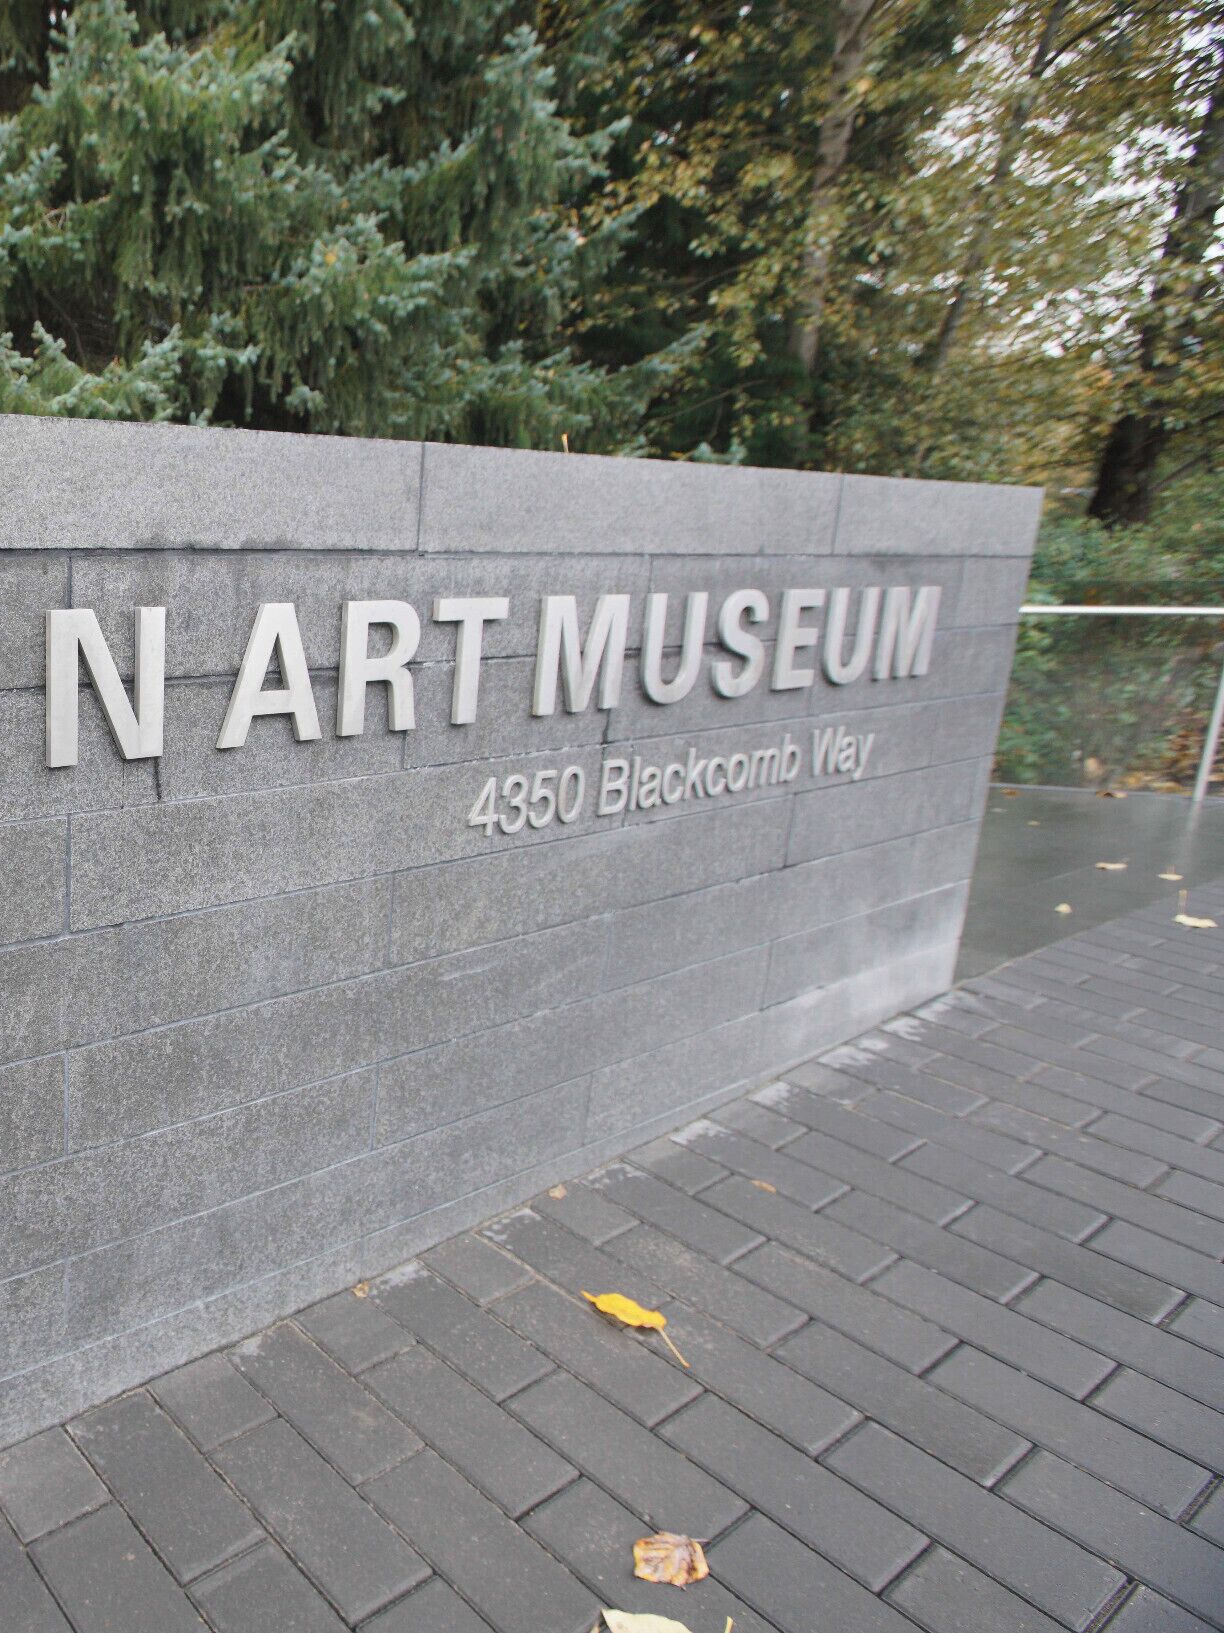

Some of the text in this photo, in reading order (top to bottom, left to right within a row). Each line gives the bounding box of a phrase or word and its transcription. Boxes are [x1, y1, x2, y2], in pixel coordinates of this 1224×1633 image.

[216, 597, 509, 749] ART
[532, 586, 942, 717] MUSEUM
[468, 726, 875, 836] 4350 Blackcomb Way
